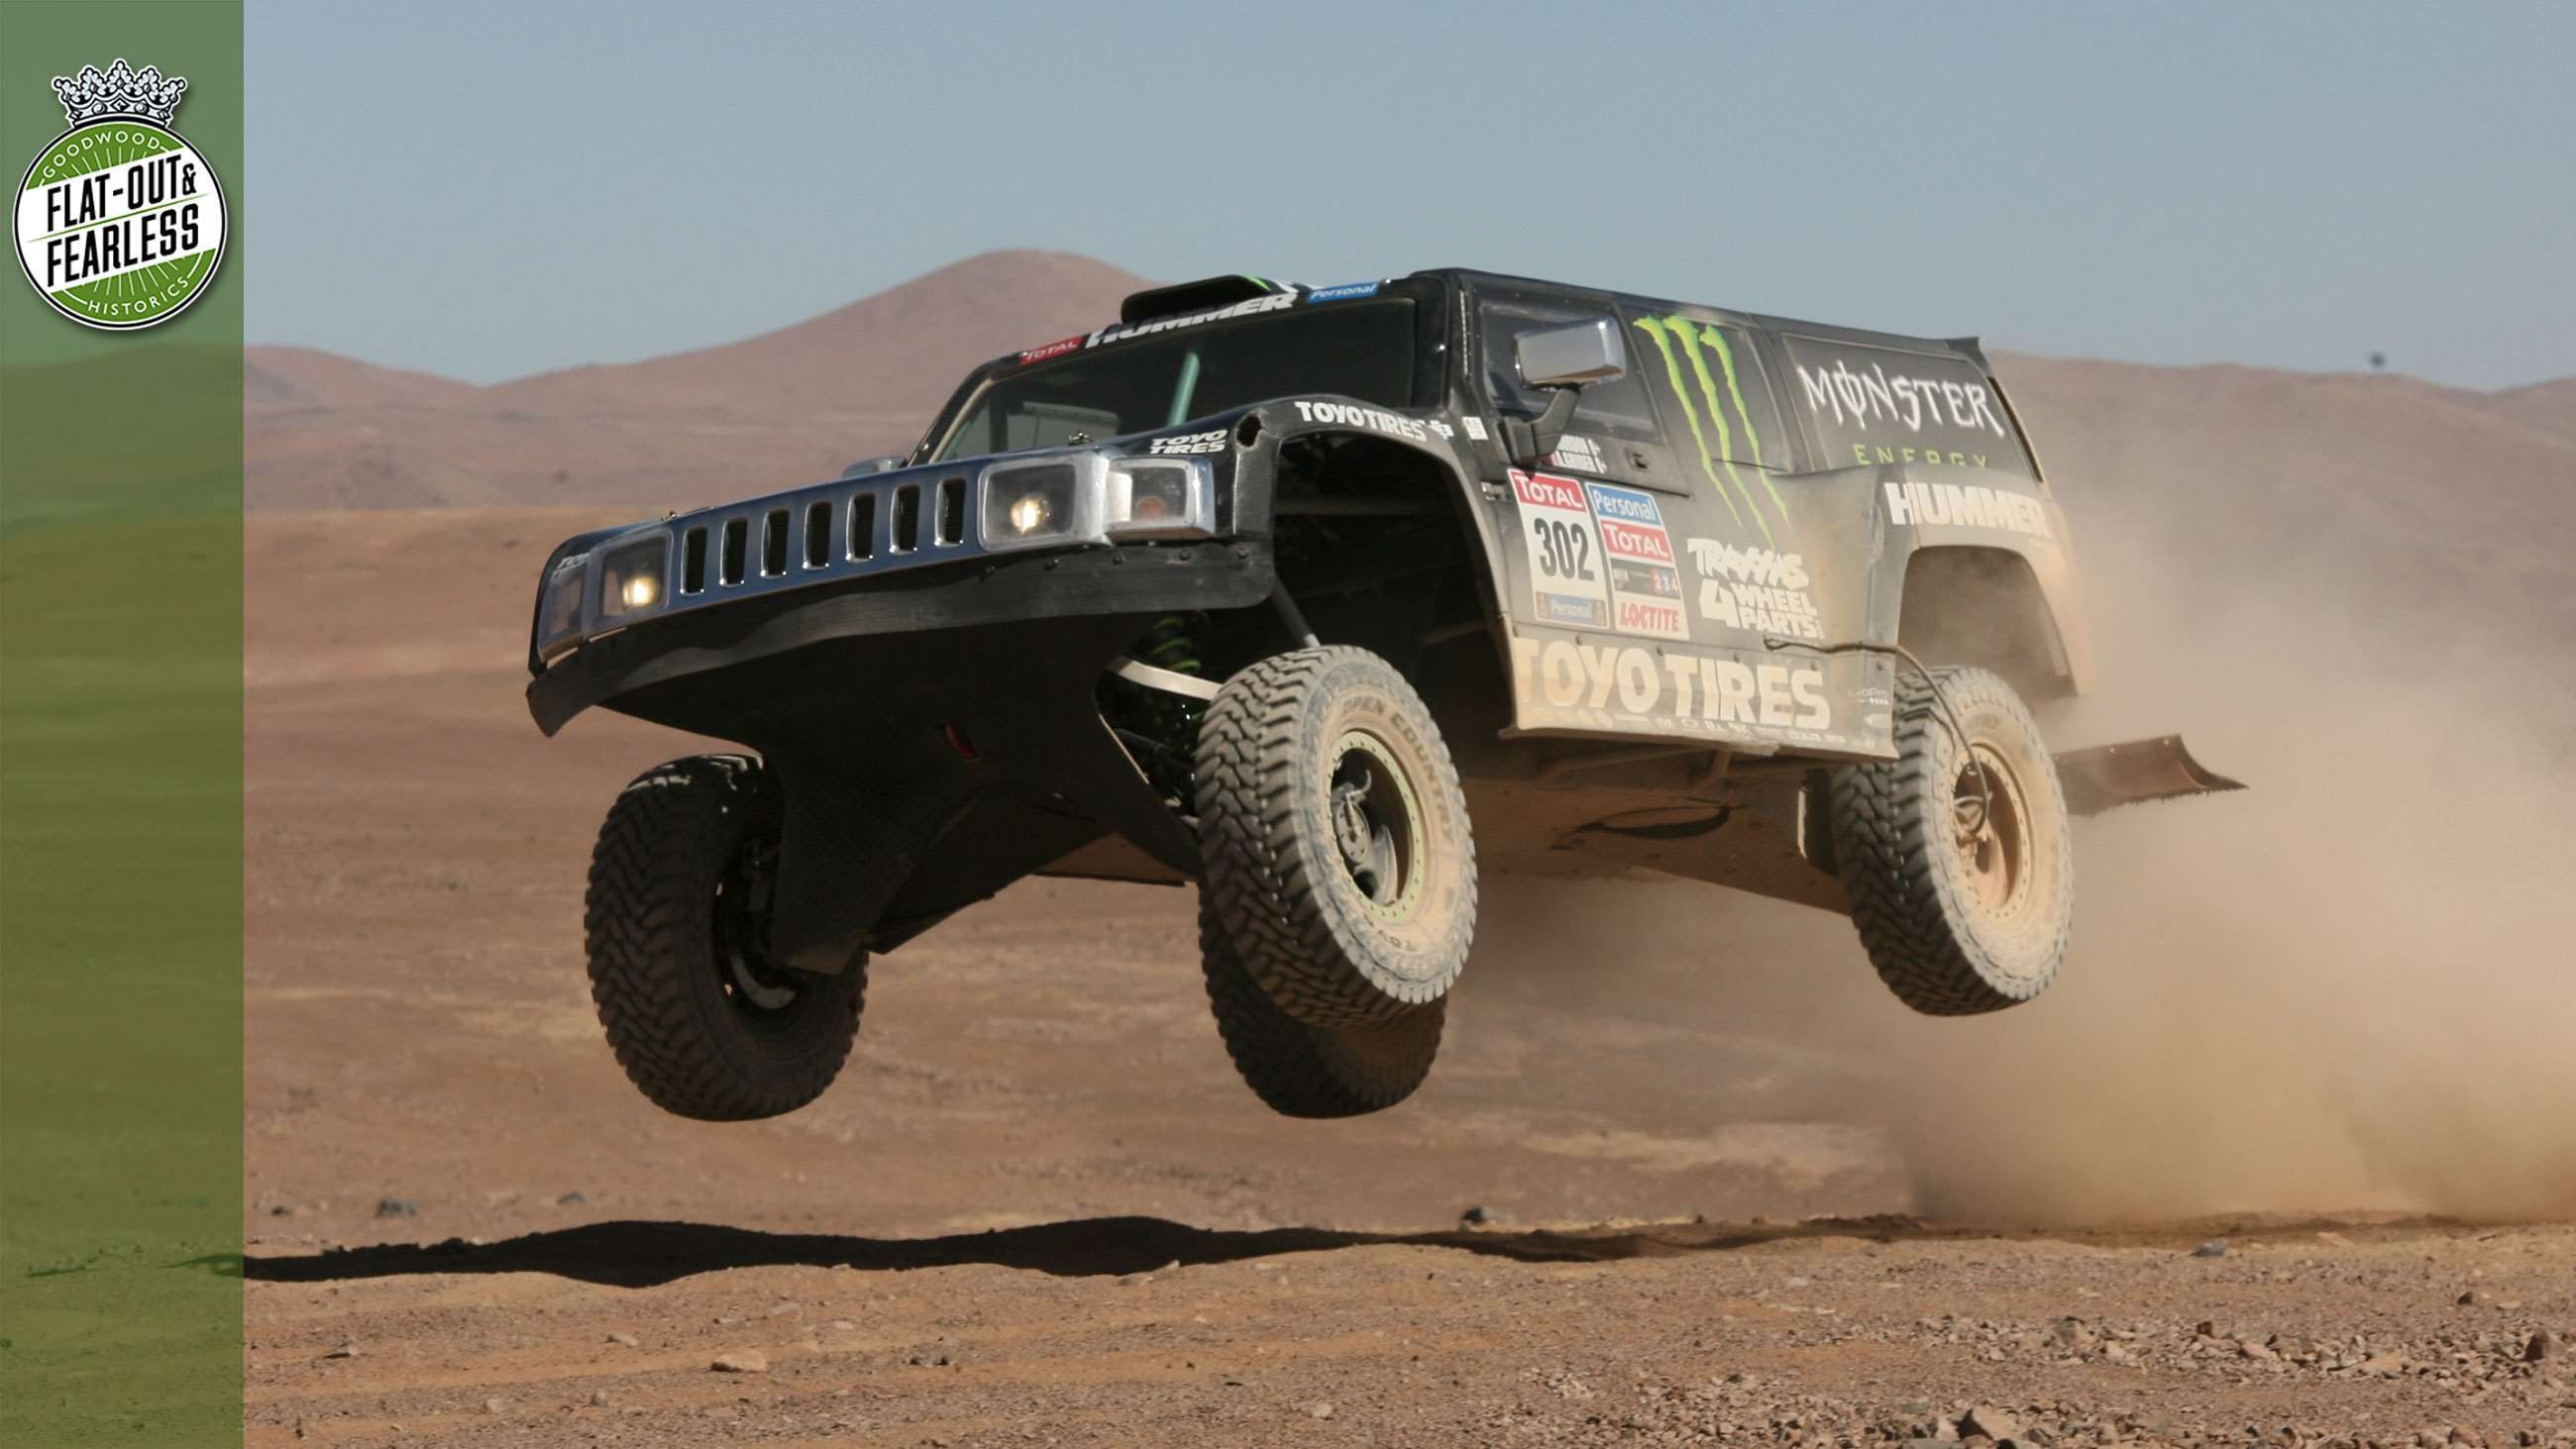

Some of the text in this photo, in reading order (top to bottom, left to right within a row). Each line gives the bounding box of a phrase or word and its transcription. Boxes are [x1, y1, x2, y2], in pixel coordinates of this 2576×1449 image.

[1310, 283, 1376, 300] Personal
[1024, 340, 1078, 362] TOTAL
[1150, 440, 1227, 455] TIRES
[1152, 429, 1229, 446] TOYO
[1514, 474, 1583, 509] TOTAL
[1591, 489, 1658, 521] Personal
[1884, 481, 2054, 540] HUMMER
[1534, 517, 1595, 581] 302
[1603, 523, 1669, 559] TOTAL
[1619, 602, 1680, 632] LOCTITE
[1699, 578, 1741, 629] 4
[1730, 581, 1818, 617] WHEEL
[1739, 606, 1818, 640] PARTS
[1513, 636, 1661, 714] TOYO
[1664, 652, 1831, 730] TIRES
